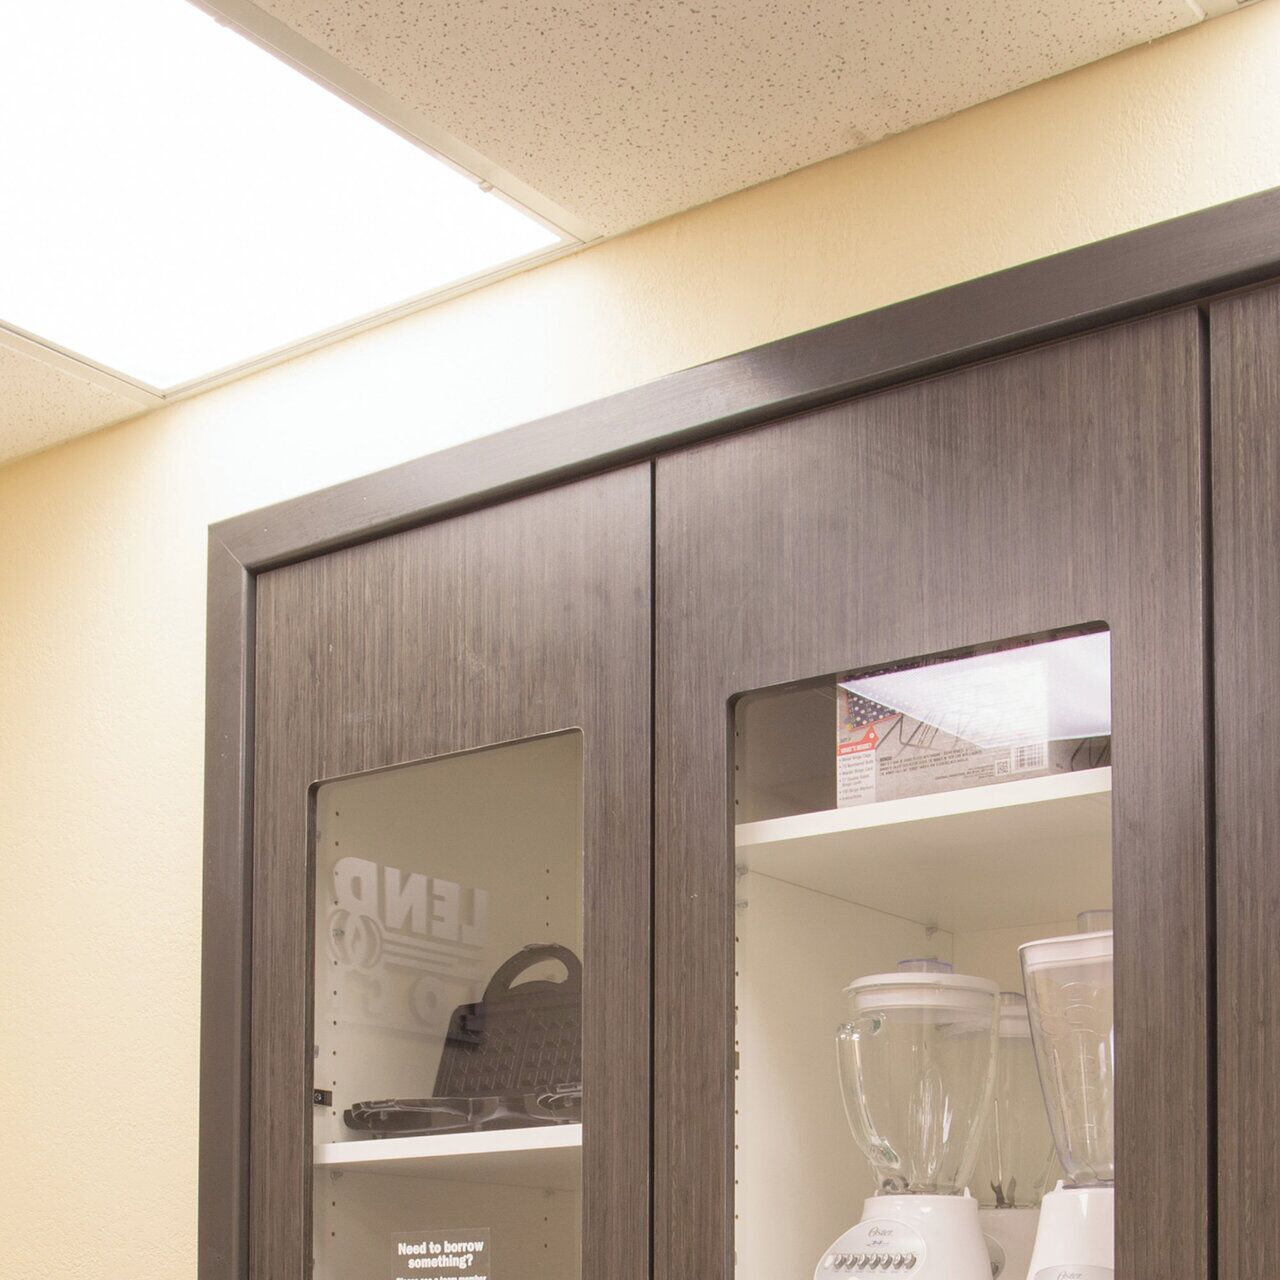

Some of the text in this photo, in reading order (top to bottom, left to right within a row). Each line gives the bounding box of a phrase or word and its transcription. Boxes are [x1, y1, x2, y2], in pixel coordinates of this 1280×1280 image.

[398, 1240, 484, 1255] Need to borrow
[408, 1254, 473, 1269] something?
